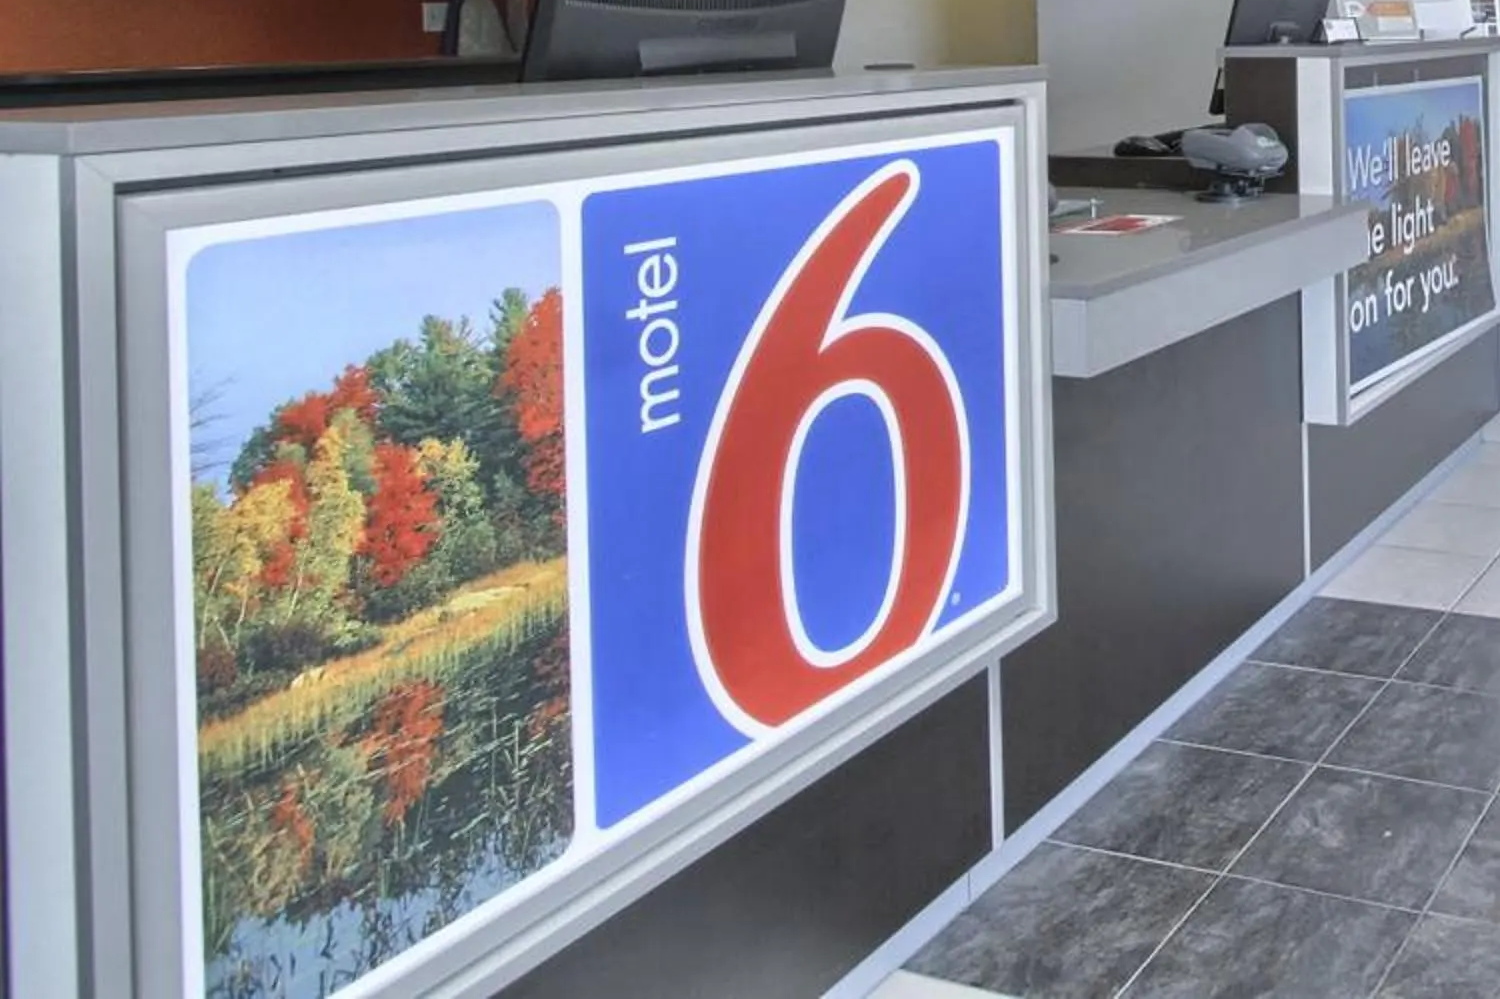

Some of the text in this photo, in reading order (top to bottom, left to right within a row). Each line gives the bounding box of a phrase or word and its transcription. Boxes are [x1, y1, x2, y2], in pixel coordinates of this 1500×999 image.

[1348, 133, 1451, 190] We'll leave
[1391, 196, 1435, 255] light
[1350, 294, 1378, 334] on
[1385, 272, 1415, 316] for
[624, 236, 681, 434] motel
[685, 158, 971, 741] 6
